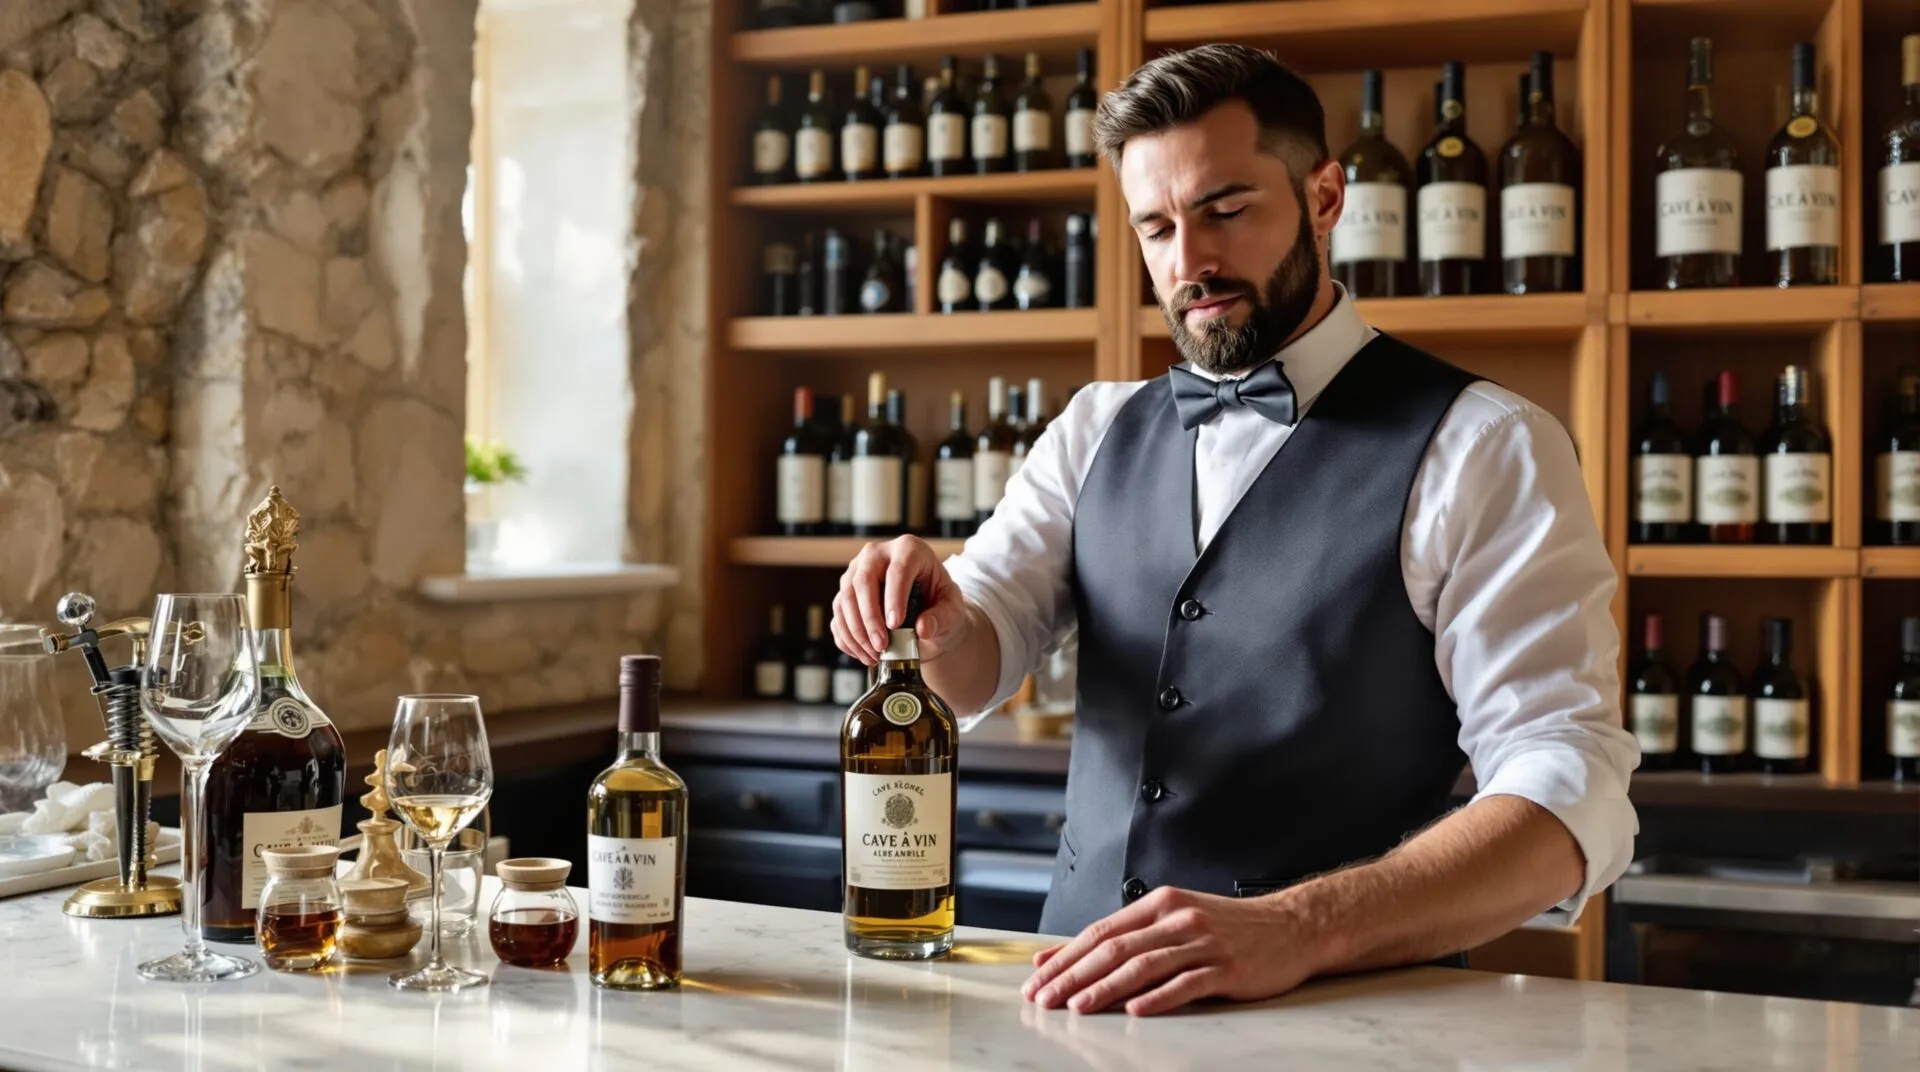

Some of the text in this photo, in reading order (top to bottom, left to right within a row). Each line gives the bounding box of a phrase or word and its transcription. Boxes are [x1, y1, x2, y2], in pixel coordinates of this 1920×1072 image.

[872, 783, 892, 797] CAVE
[862, 833, 898, 848] CAVE
[913, 833, 937, 847] VIN
[632, 852, 656, 866] VIN
